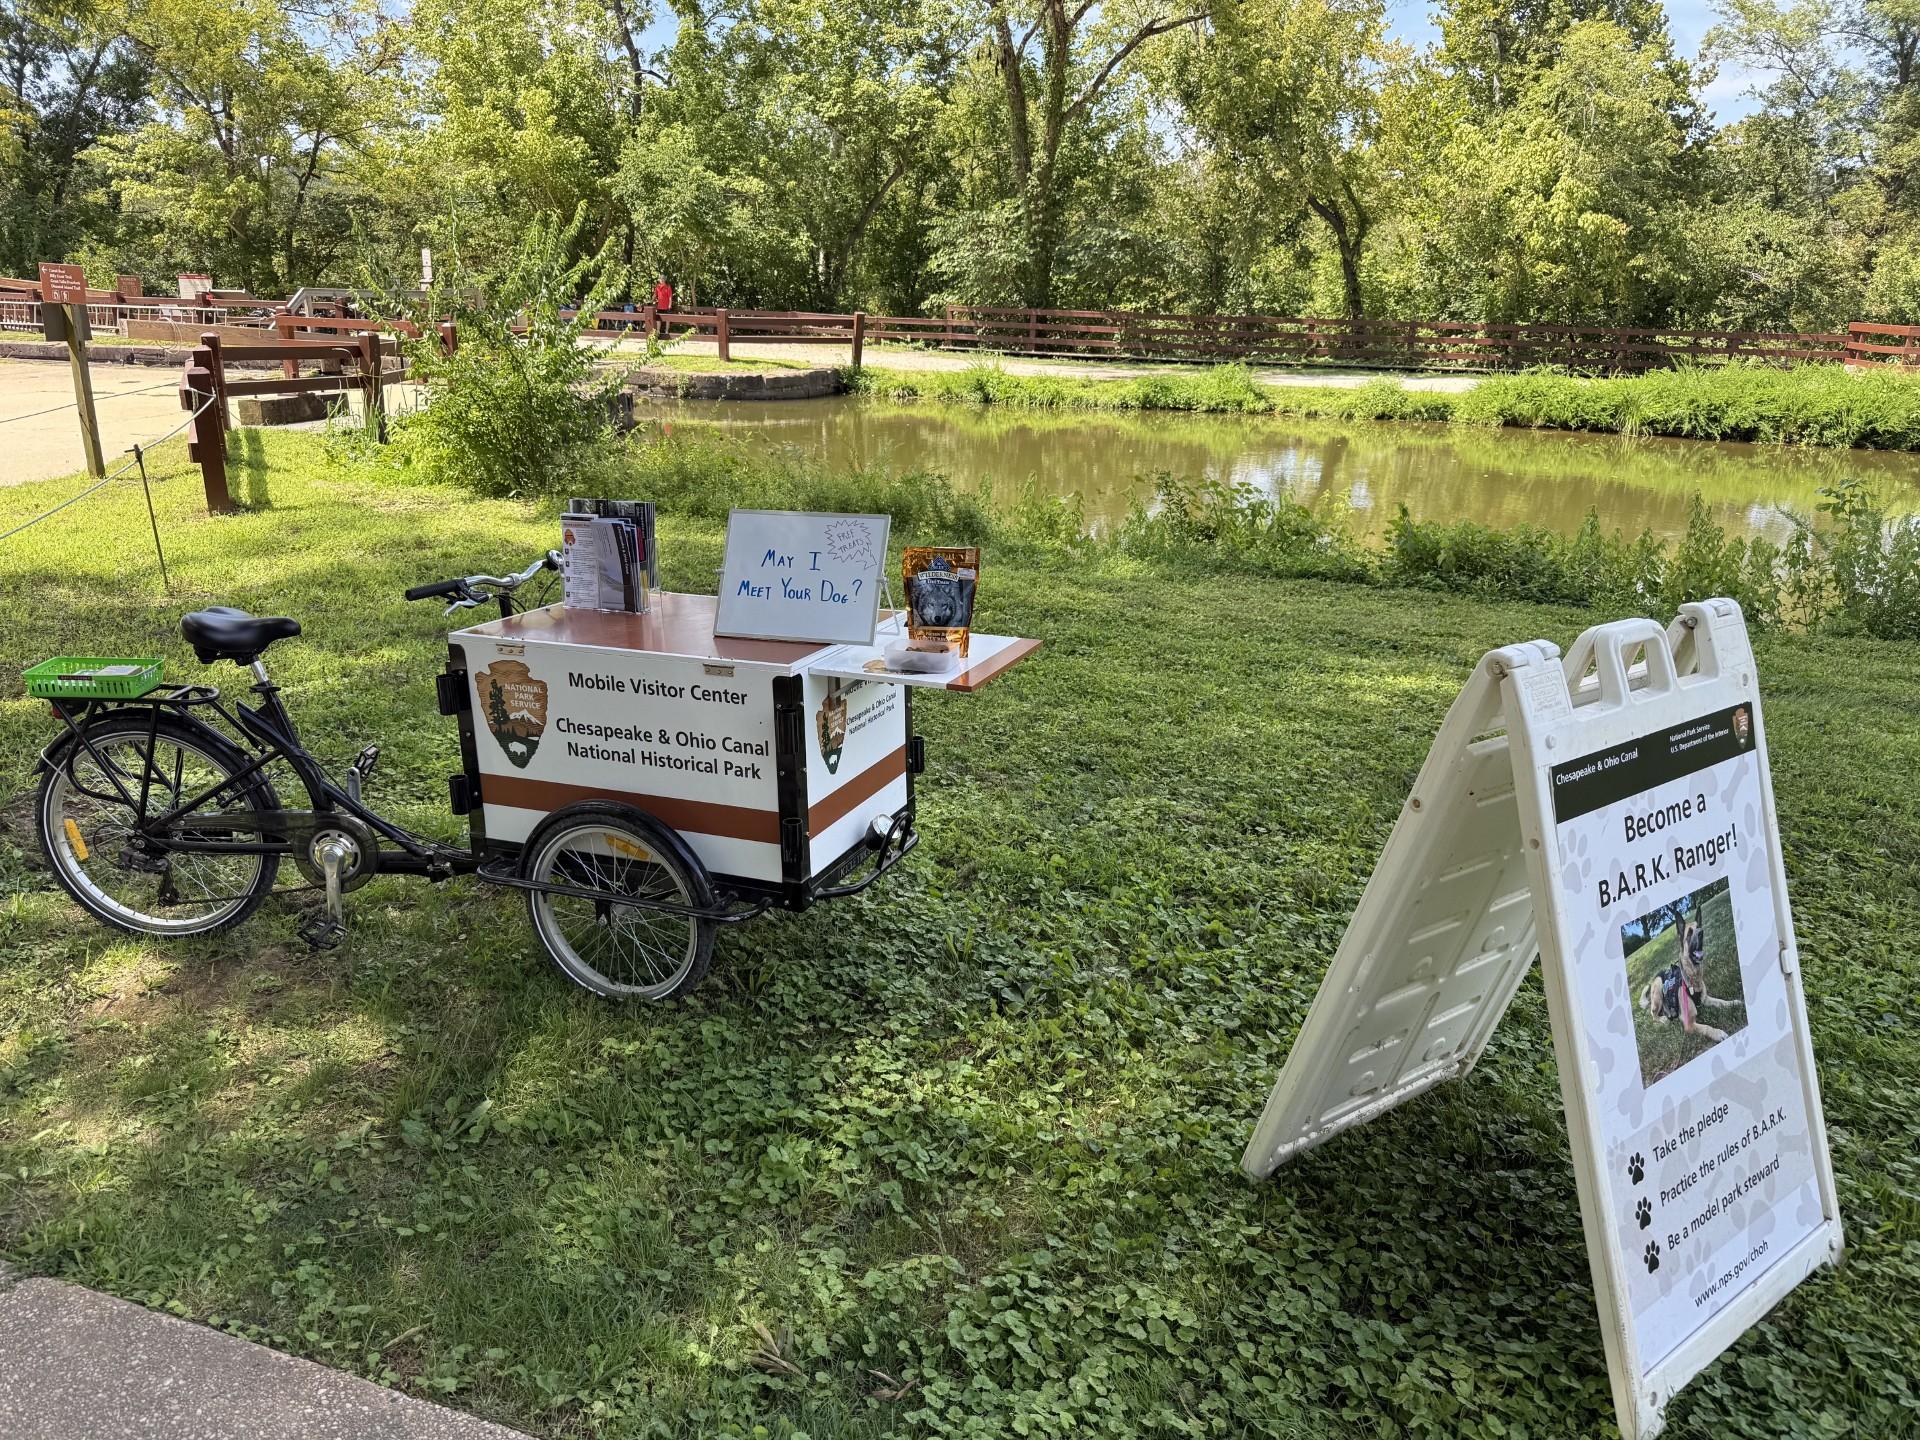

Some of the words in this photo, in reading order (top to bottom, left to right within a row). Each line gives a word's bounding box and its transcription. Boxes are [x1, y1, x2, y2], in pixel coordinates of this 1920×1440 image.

[838, 538, 865, 554] TREATS
[808, 551, 822, 572] I
[737, 579, 772, 600] MEET
[504, 683, 543, 694] NATIONAL
[514, 692, 534, 701] PARK
[568, 672, 626, 693] Mobile
[629, 678, 686, 699] Visitor
[690, 684, 748, 705] Center
[876, 698, 886, 708] Ohio
[886, 689, 897, 703] Canal
[510, 700, 541, 710] SERVICE
[556, 717, 653, 742] Chesapeake
[658, 729, 671, 745] &
[675, 731, 717, 750] Ohio
[722, 736, 770, 757] Canal
[848, 718, 867, 736] National
[1670, 731, 1687, 742] National
[1687, 728, 1696, 737] Park
[1696, 724, 1710, 734] Service
[1670, 746, 1679, 754] U.S.
[1679, 737, 1703, 751] Department
[1715, 728, 1729, 739] Interior
[567, 741, 636, 765] National
[641, 750, 718, 775] Historical
[724, 760, 762, 780] Park
[1556, 763, 1596, 785] Chesapeake
[1597, 761, 1603, 771] &
[1604, 756, 1620, 768] Ohio
[1620, 748, 1638, 764] Canal
[1624, 798, 1692, 843] Become
[1696, 793, 1707, 813] a
[1598, 854, 1670, 909] B.A.R.K.
[1674, 823, 1738, 874] Ranger!
[1652, 1140, 1678, 1163] Take
[1678, 1128, 1696, 1146] the
[1697, 1103, 1730, 1136] pledge
[1660, 1172, 1698, 1207] Practice
[1698, 1160, 1716, 1178] the
[1717, 1142, 1740, 1169] rules
[1741, 1130, 1752, 1148] of
[1752, 1106, 1787, 1141] B.A.R.K.
[1667, 1233, 1681, 1252] Be
[1682, 1226, 1690, 1240] a
[1690, 1200, 1720, 1235] model
[1722, 1186, 1742, 1216] park
[1744, 1154, 1780, 1193] steward
[1694, 1239, 1769, 1308] www.nps.gov/choh
